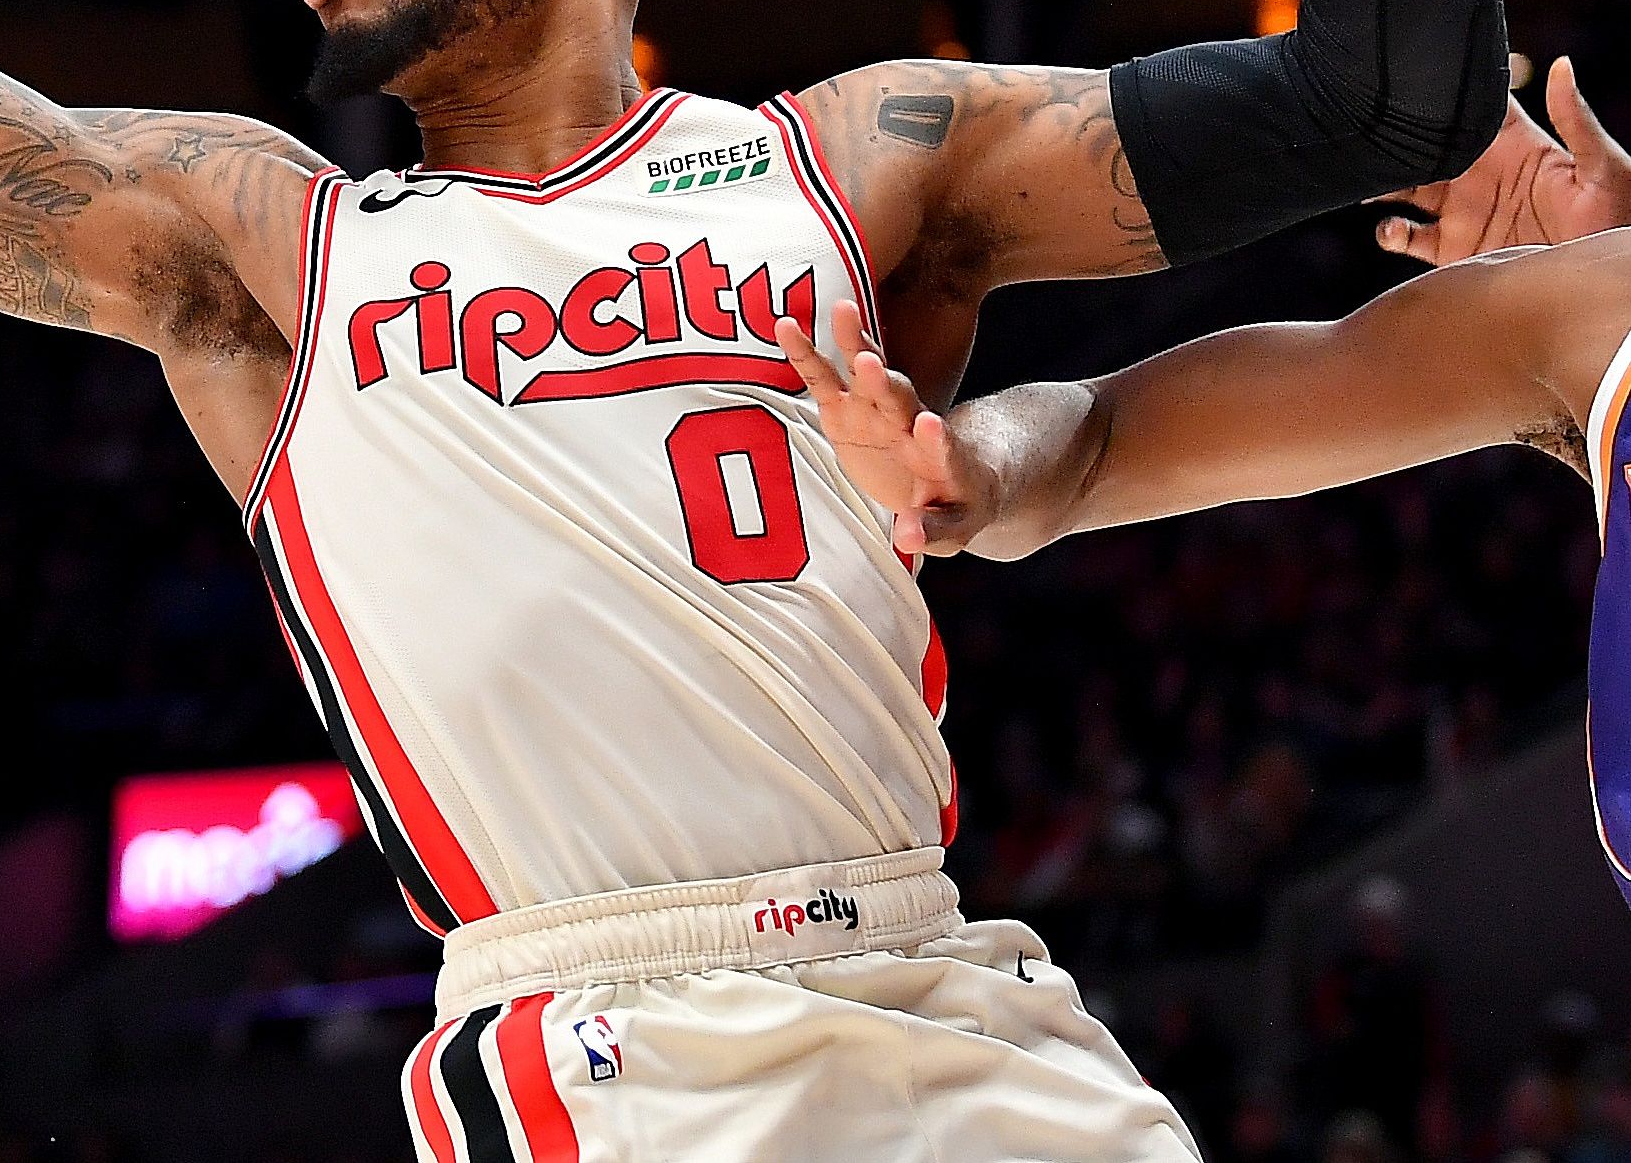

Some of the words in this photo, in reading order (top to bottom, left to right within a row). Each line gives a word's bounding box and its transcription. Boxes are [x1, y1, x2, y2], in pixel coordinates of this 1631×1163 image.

[647, 136, 770, 177] BIOFREEZE
[348, 238, 816, 406] ripcity
[665, 405, 810, 585] 0
[754, 889, 859, 937] ripcity
